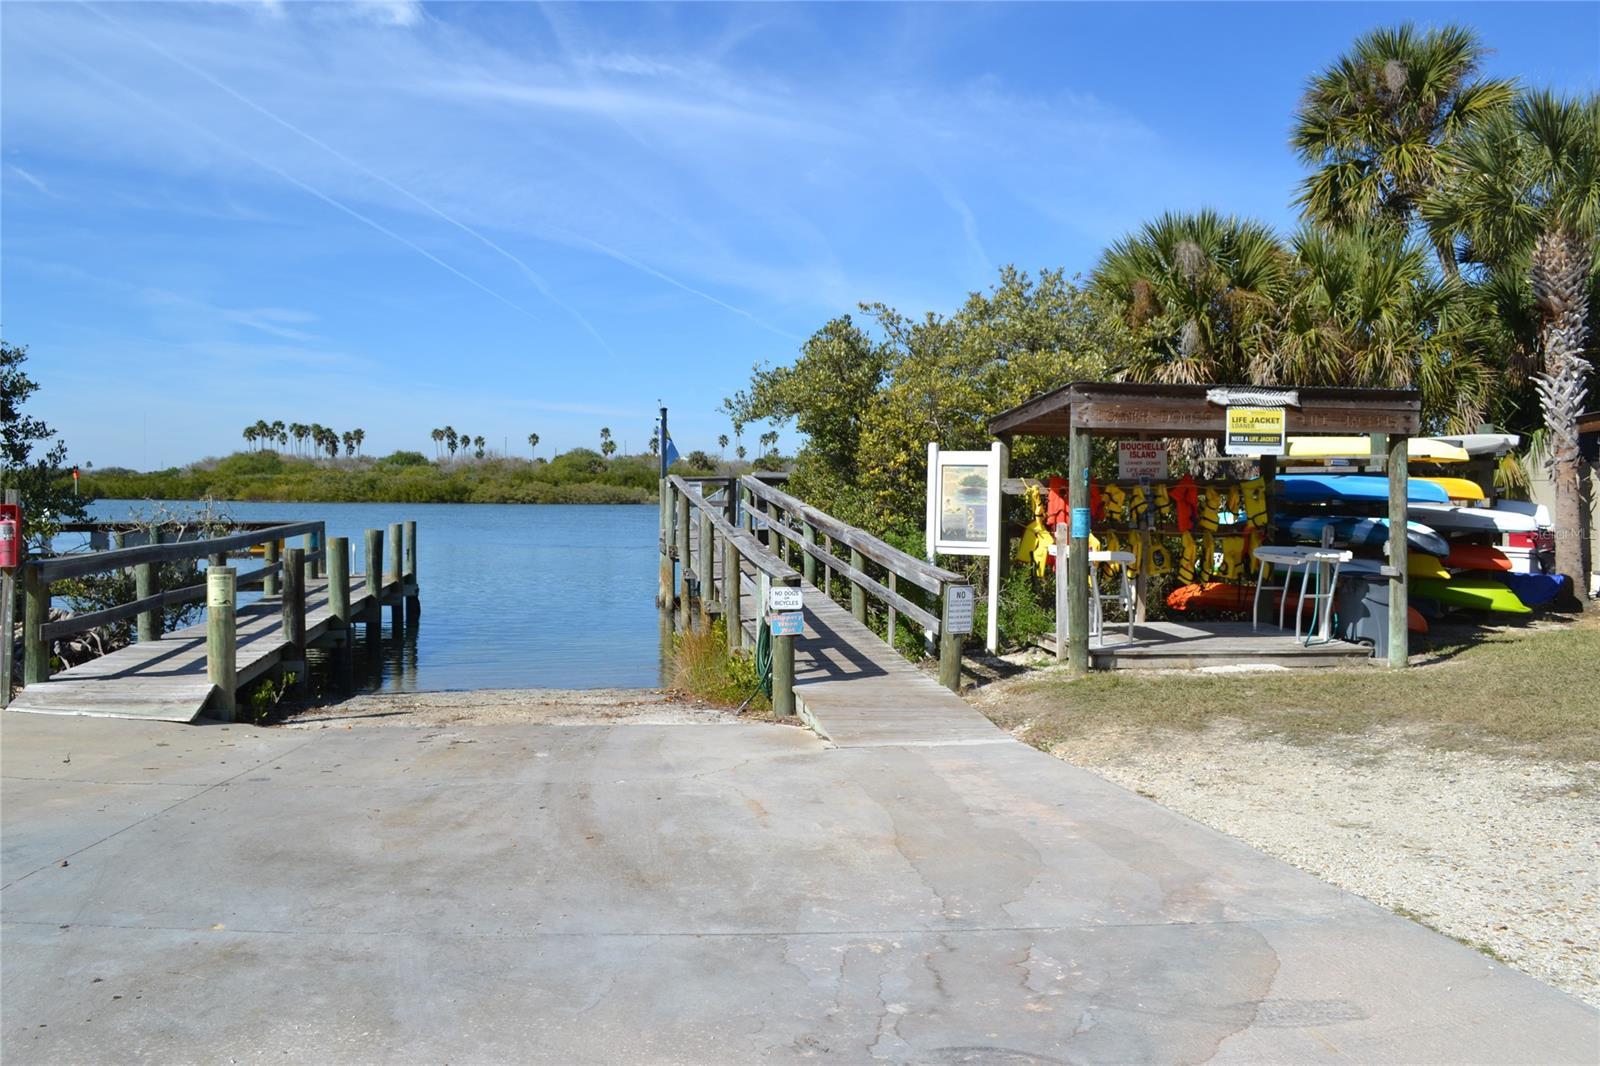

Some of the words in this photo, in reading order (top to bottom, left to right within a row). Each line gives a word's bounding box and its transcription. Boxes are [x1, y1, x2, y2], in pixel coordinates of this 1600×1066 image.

[1231, 416, 1248, 424] LIFE
[1249, 417, 1281, 425] JACKET
[1120, 442, 1165, 451] BOUCHELLE
[1129, 451, 1157, 459] ISLAND
[956, 591, 966, 599] NO
